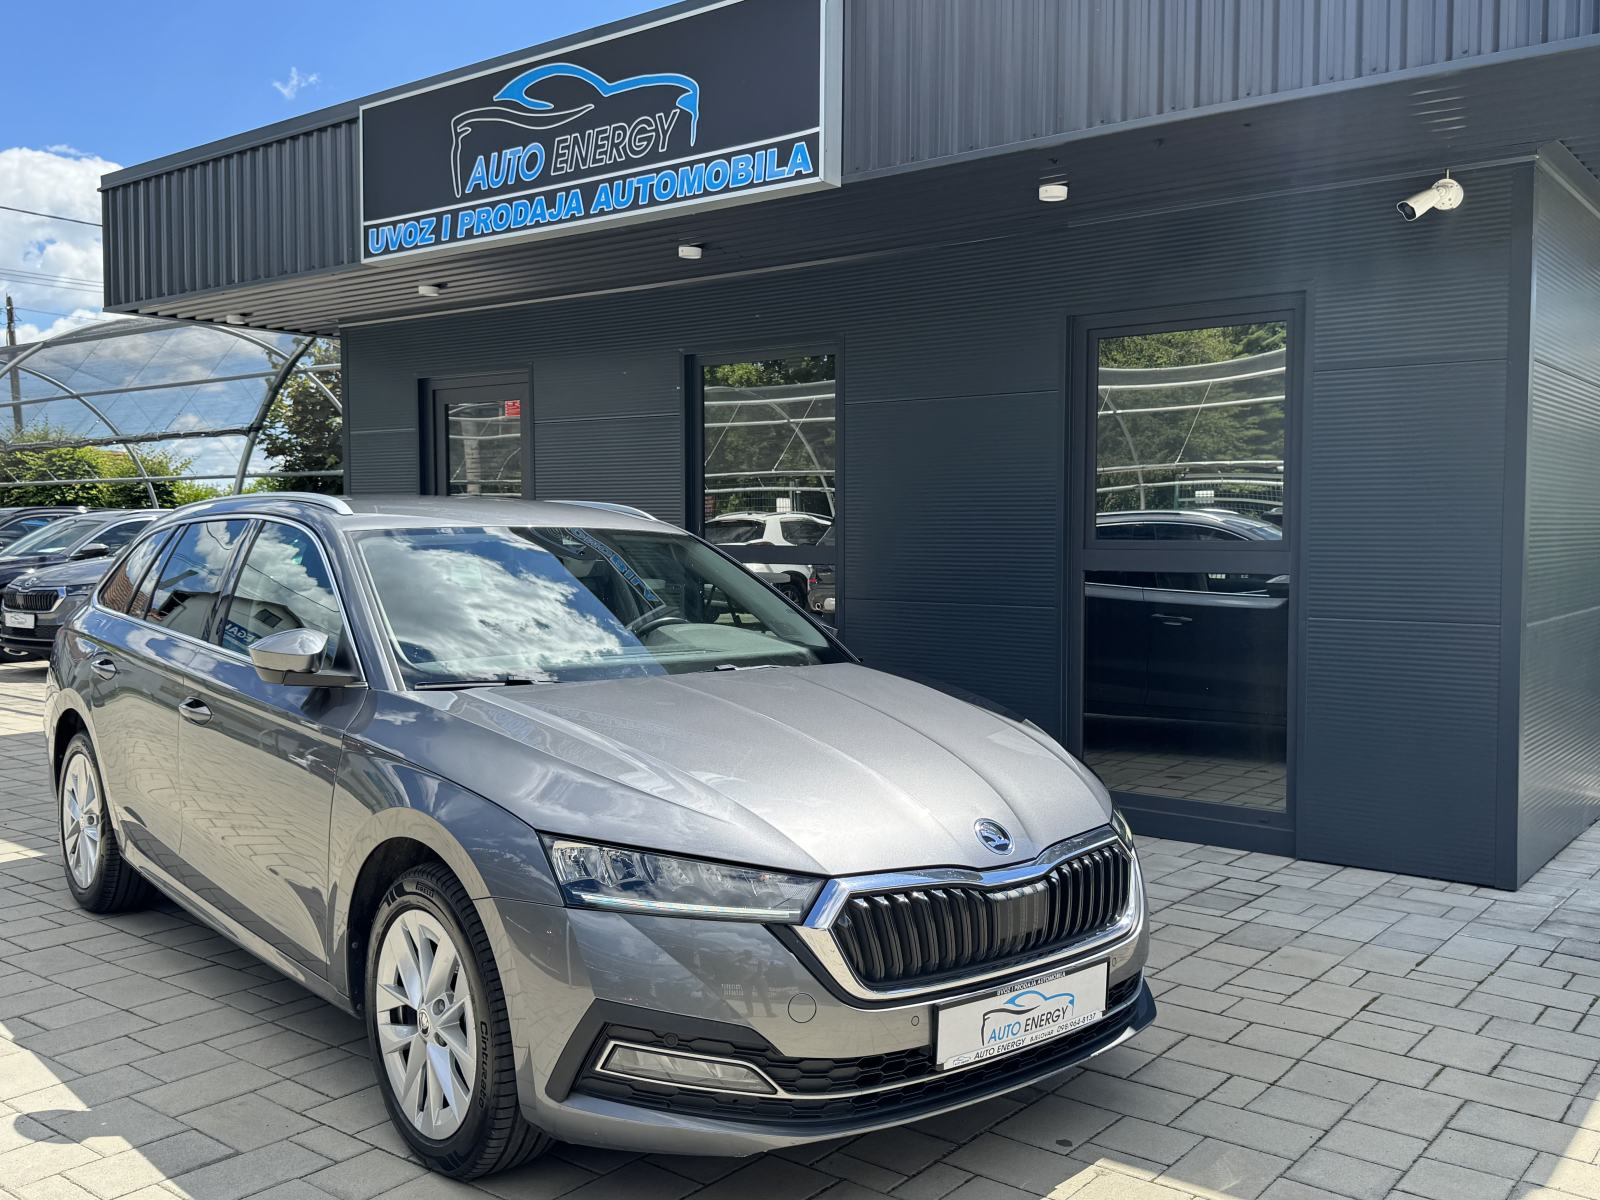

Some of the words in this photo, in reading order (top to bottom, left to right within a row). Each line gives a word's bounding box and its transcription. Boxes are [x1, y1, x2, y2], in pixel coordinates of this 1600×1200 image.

[465, 142, 545, 194] AUTO
[550, 109, 680, 176] ENERGY
[368, 217, 436, 255] UVOZ
[441, 214, 451, 240] I
[457, 189, 584, 239] PRODAJA
[590, 141, 814, 215] AUTOMOBILA
[479, 1021, 489, 1109] Cinturato
[974, 1047, 995, 1060] AUTO
[997, 1037, 1026, 1054] ENERGY
[988, 1021, 1021, 1043] AUTO
[1024, 1005, 1068, 1032] ENERGY
